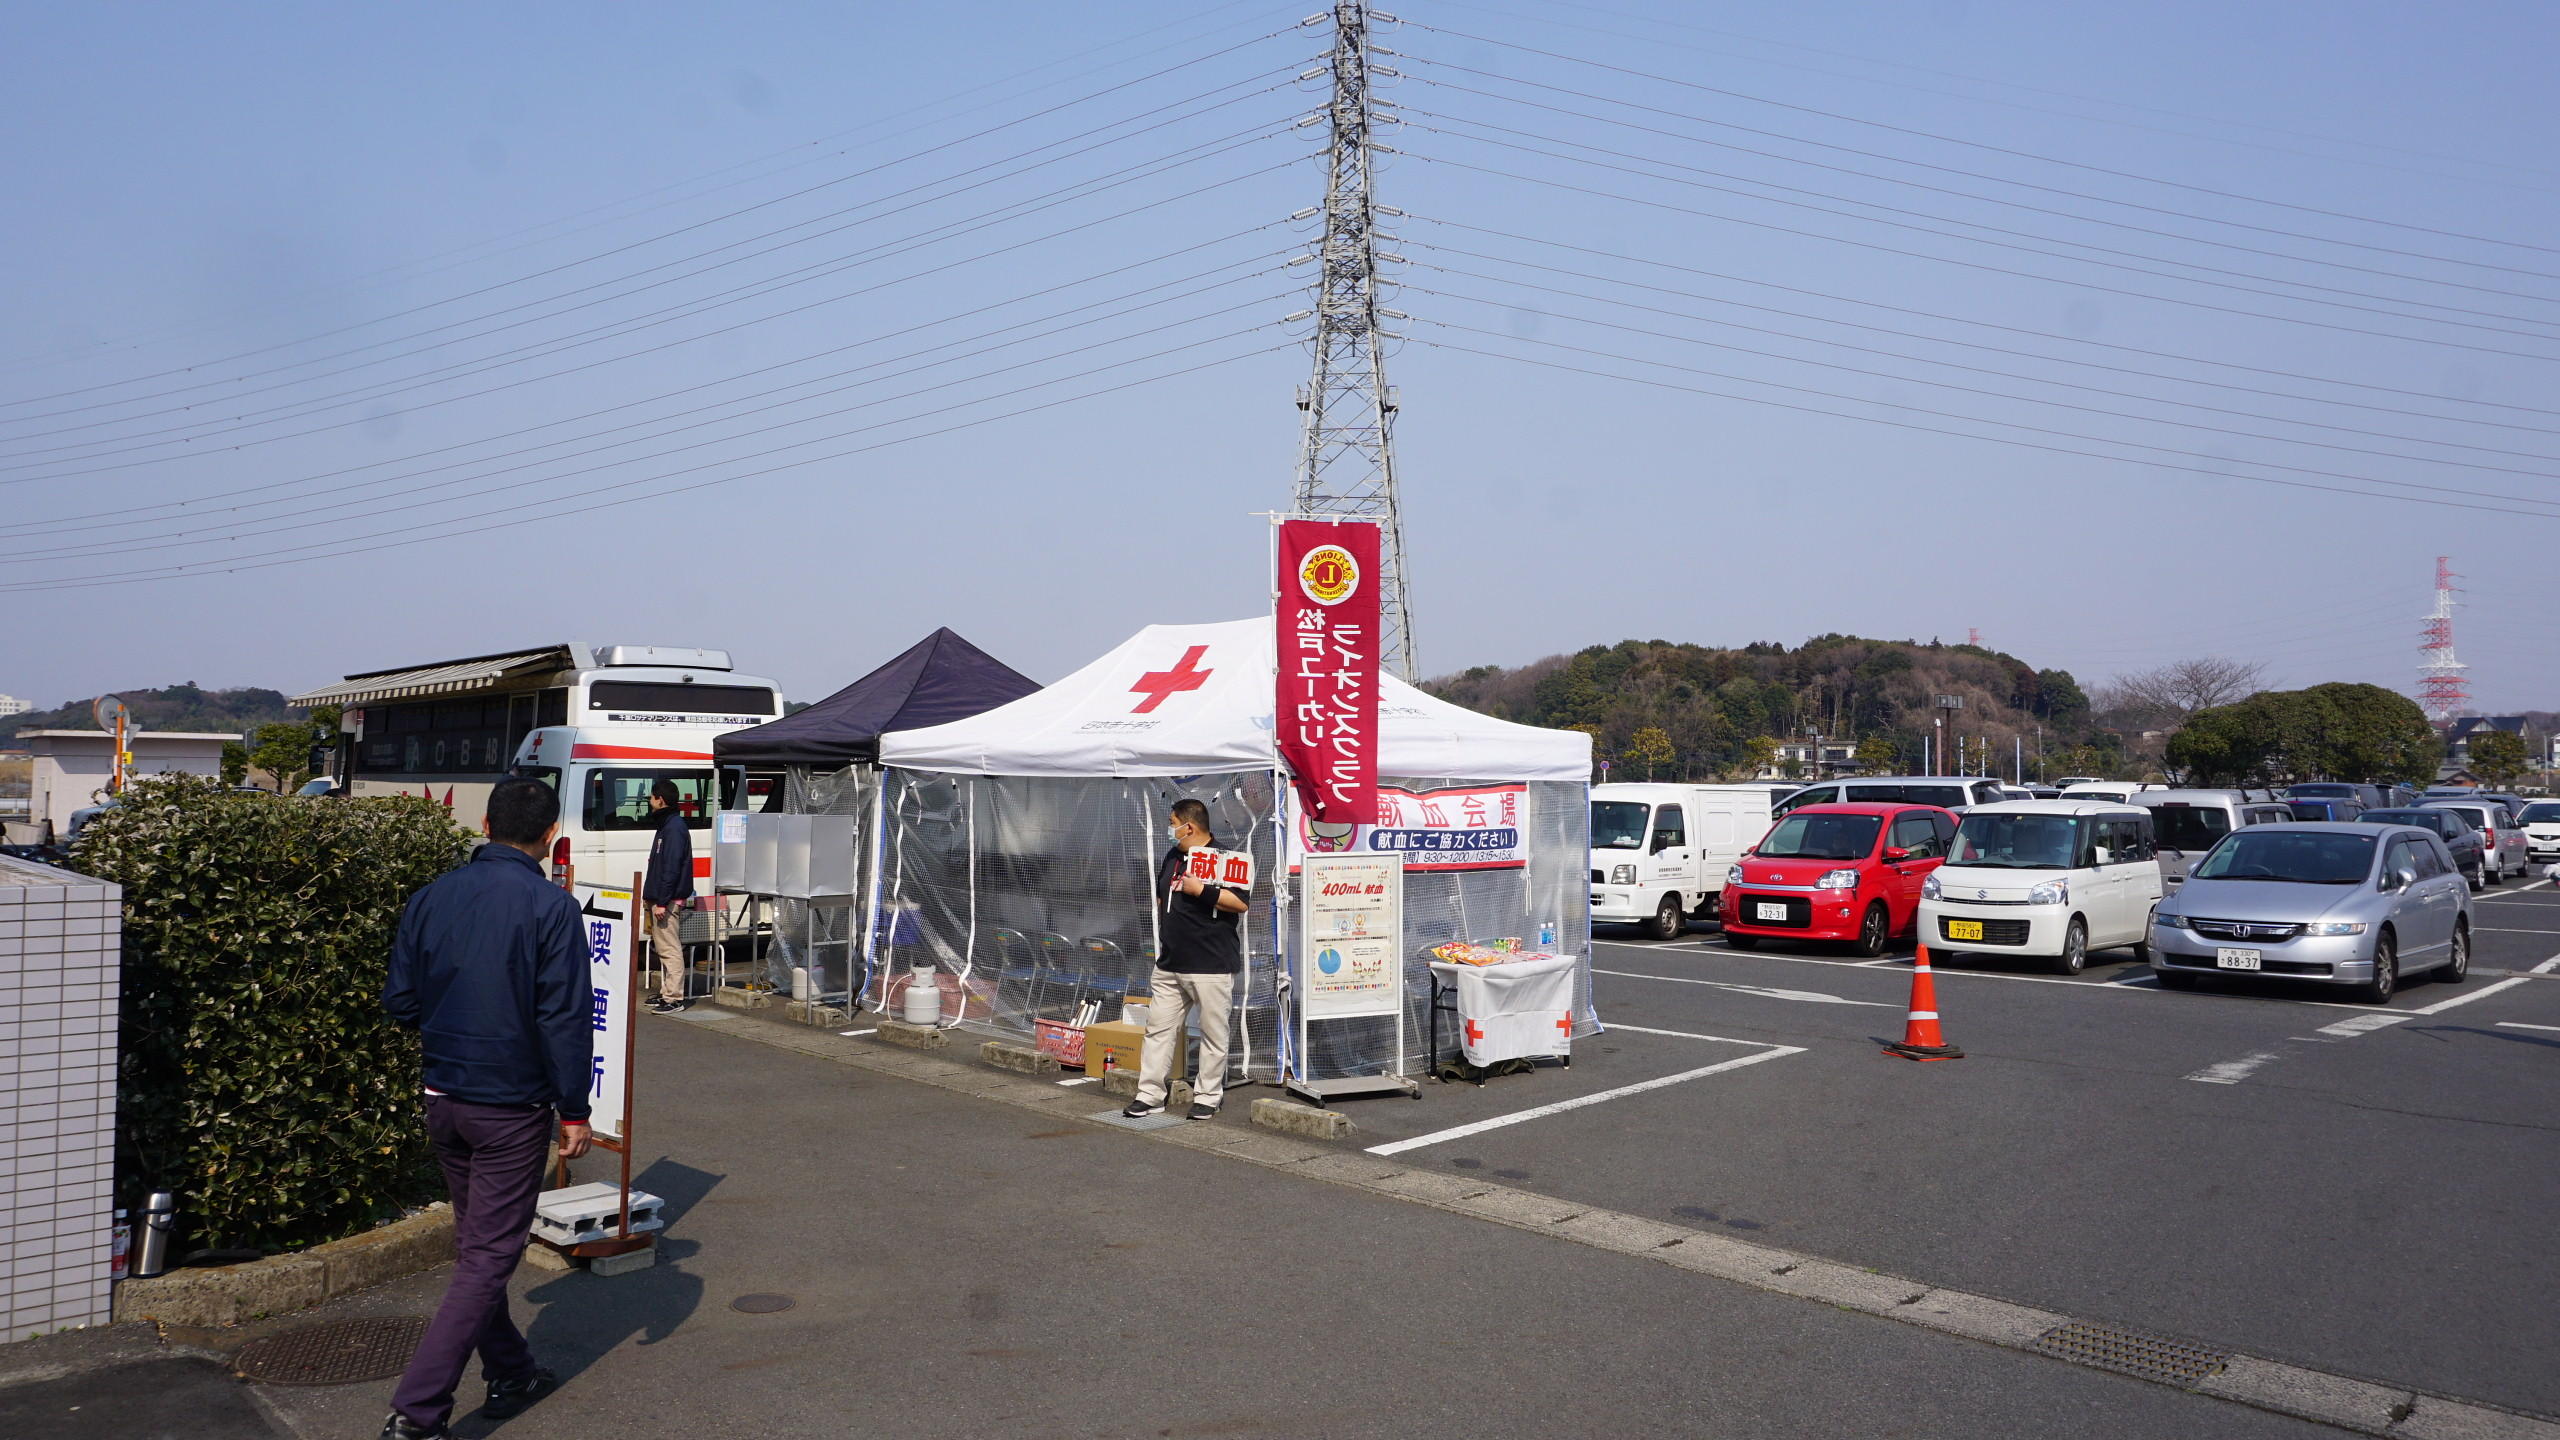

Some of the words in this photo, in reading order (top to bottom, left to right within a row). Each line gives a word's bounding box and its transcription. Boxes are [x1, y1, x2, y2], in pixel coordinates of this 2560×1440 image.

[411, 741, 420, 766] A
[434, 740, 446, 766] O
[460, 739, 471, 766] B
[484, 737, 498, 766] AB
[1375, 792, 1516, 828] 献血会場
[1377, 831, 1515, 849] 献血にご協力ください！
[1190, 851, 1249, 885] 献血
[1321, 882, 1362, 897] 400mL
[1364, 883, 1384, 895] 献血
[1955, 927, 1981, 939] 77-07
[2227, 956, 2259, 969] 88-37
